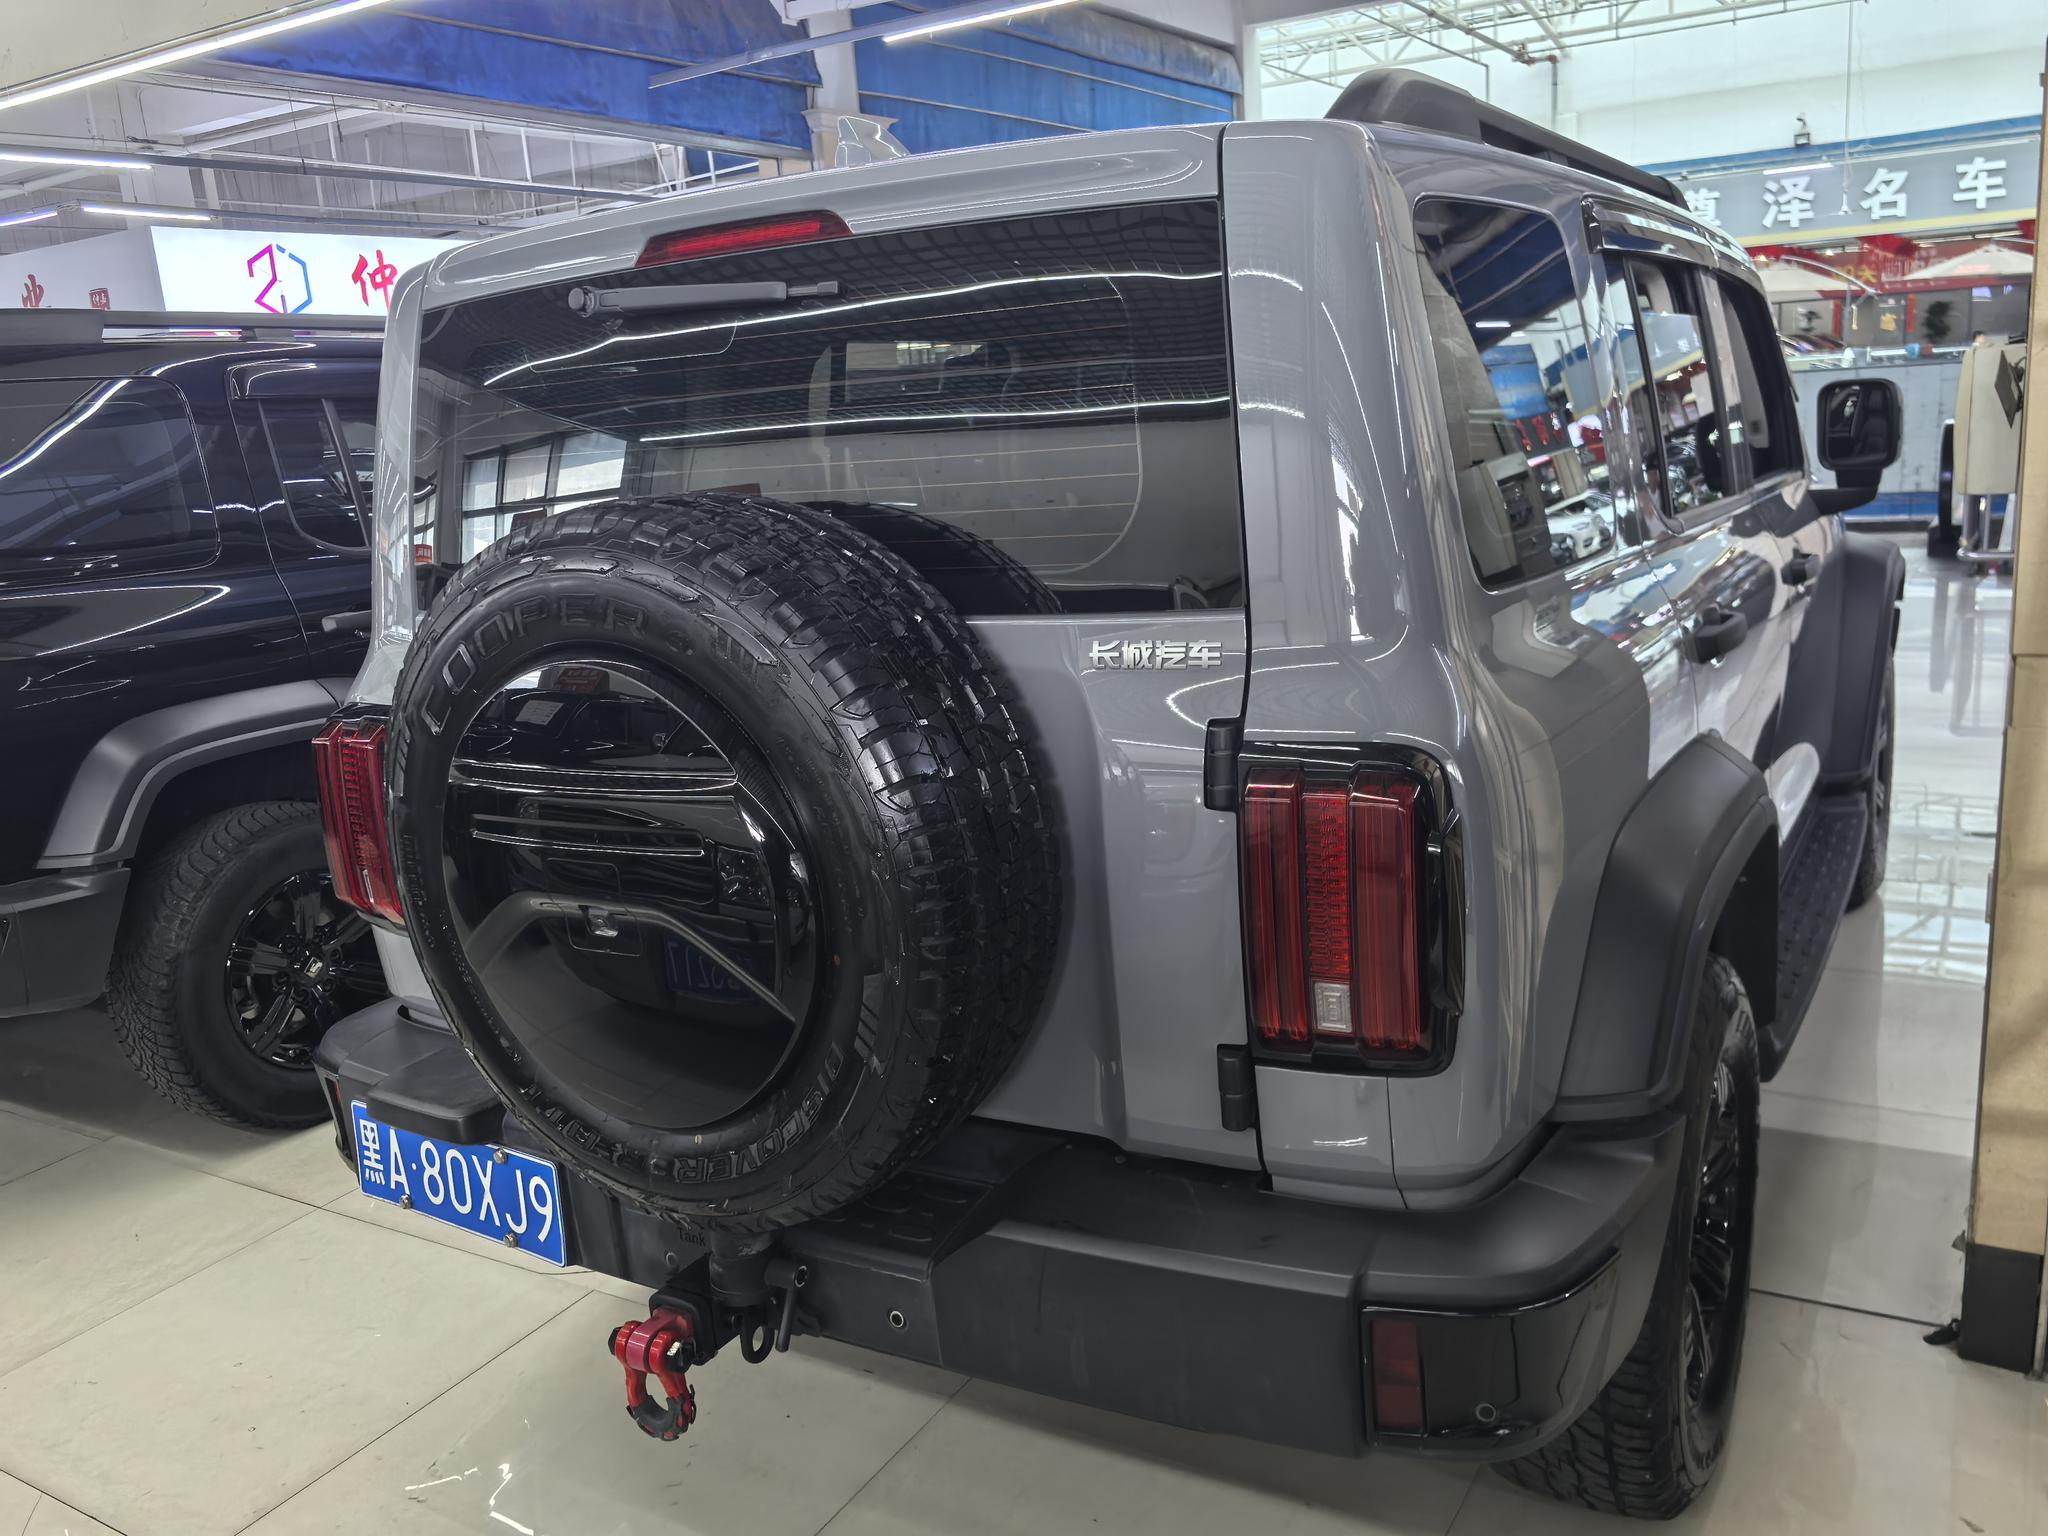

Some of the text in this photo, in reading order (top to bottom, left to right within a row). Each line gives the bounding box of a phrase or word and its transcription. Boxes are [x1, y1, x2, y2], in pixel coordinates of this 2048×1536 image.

[421, 592, 648, 736] COOPER
[1089, 639, 1222, 670] 长城汽车
[359, 1118, 553, 1243] 黑A·80XJ9
